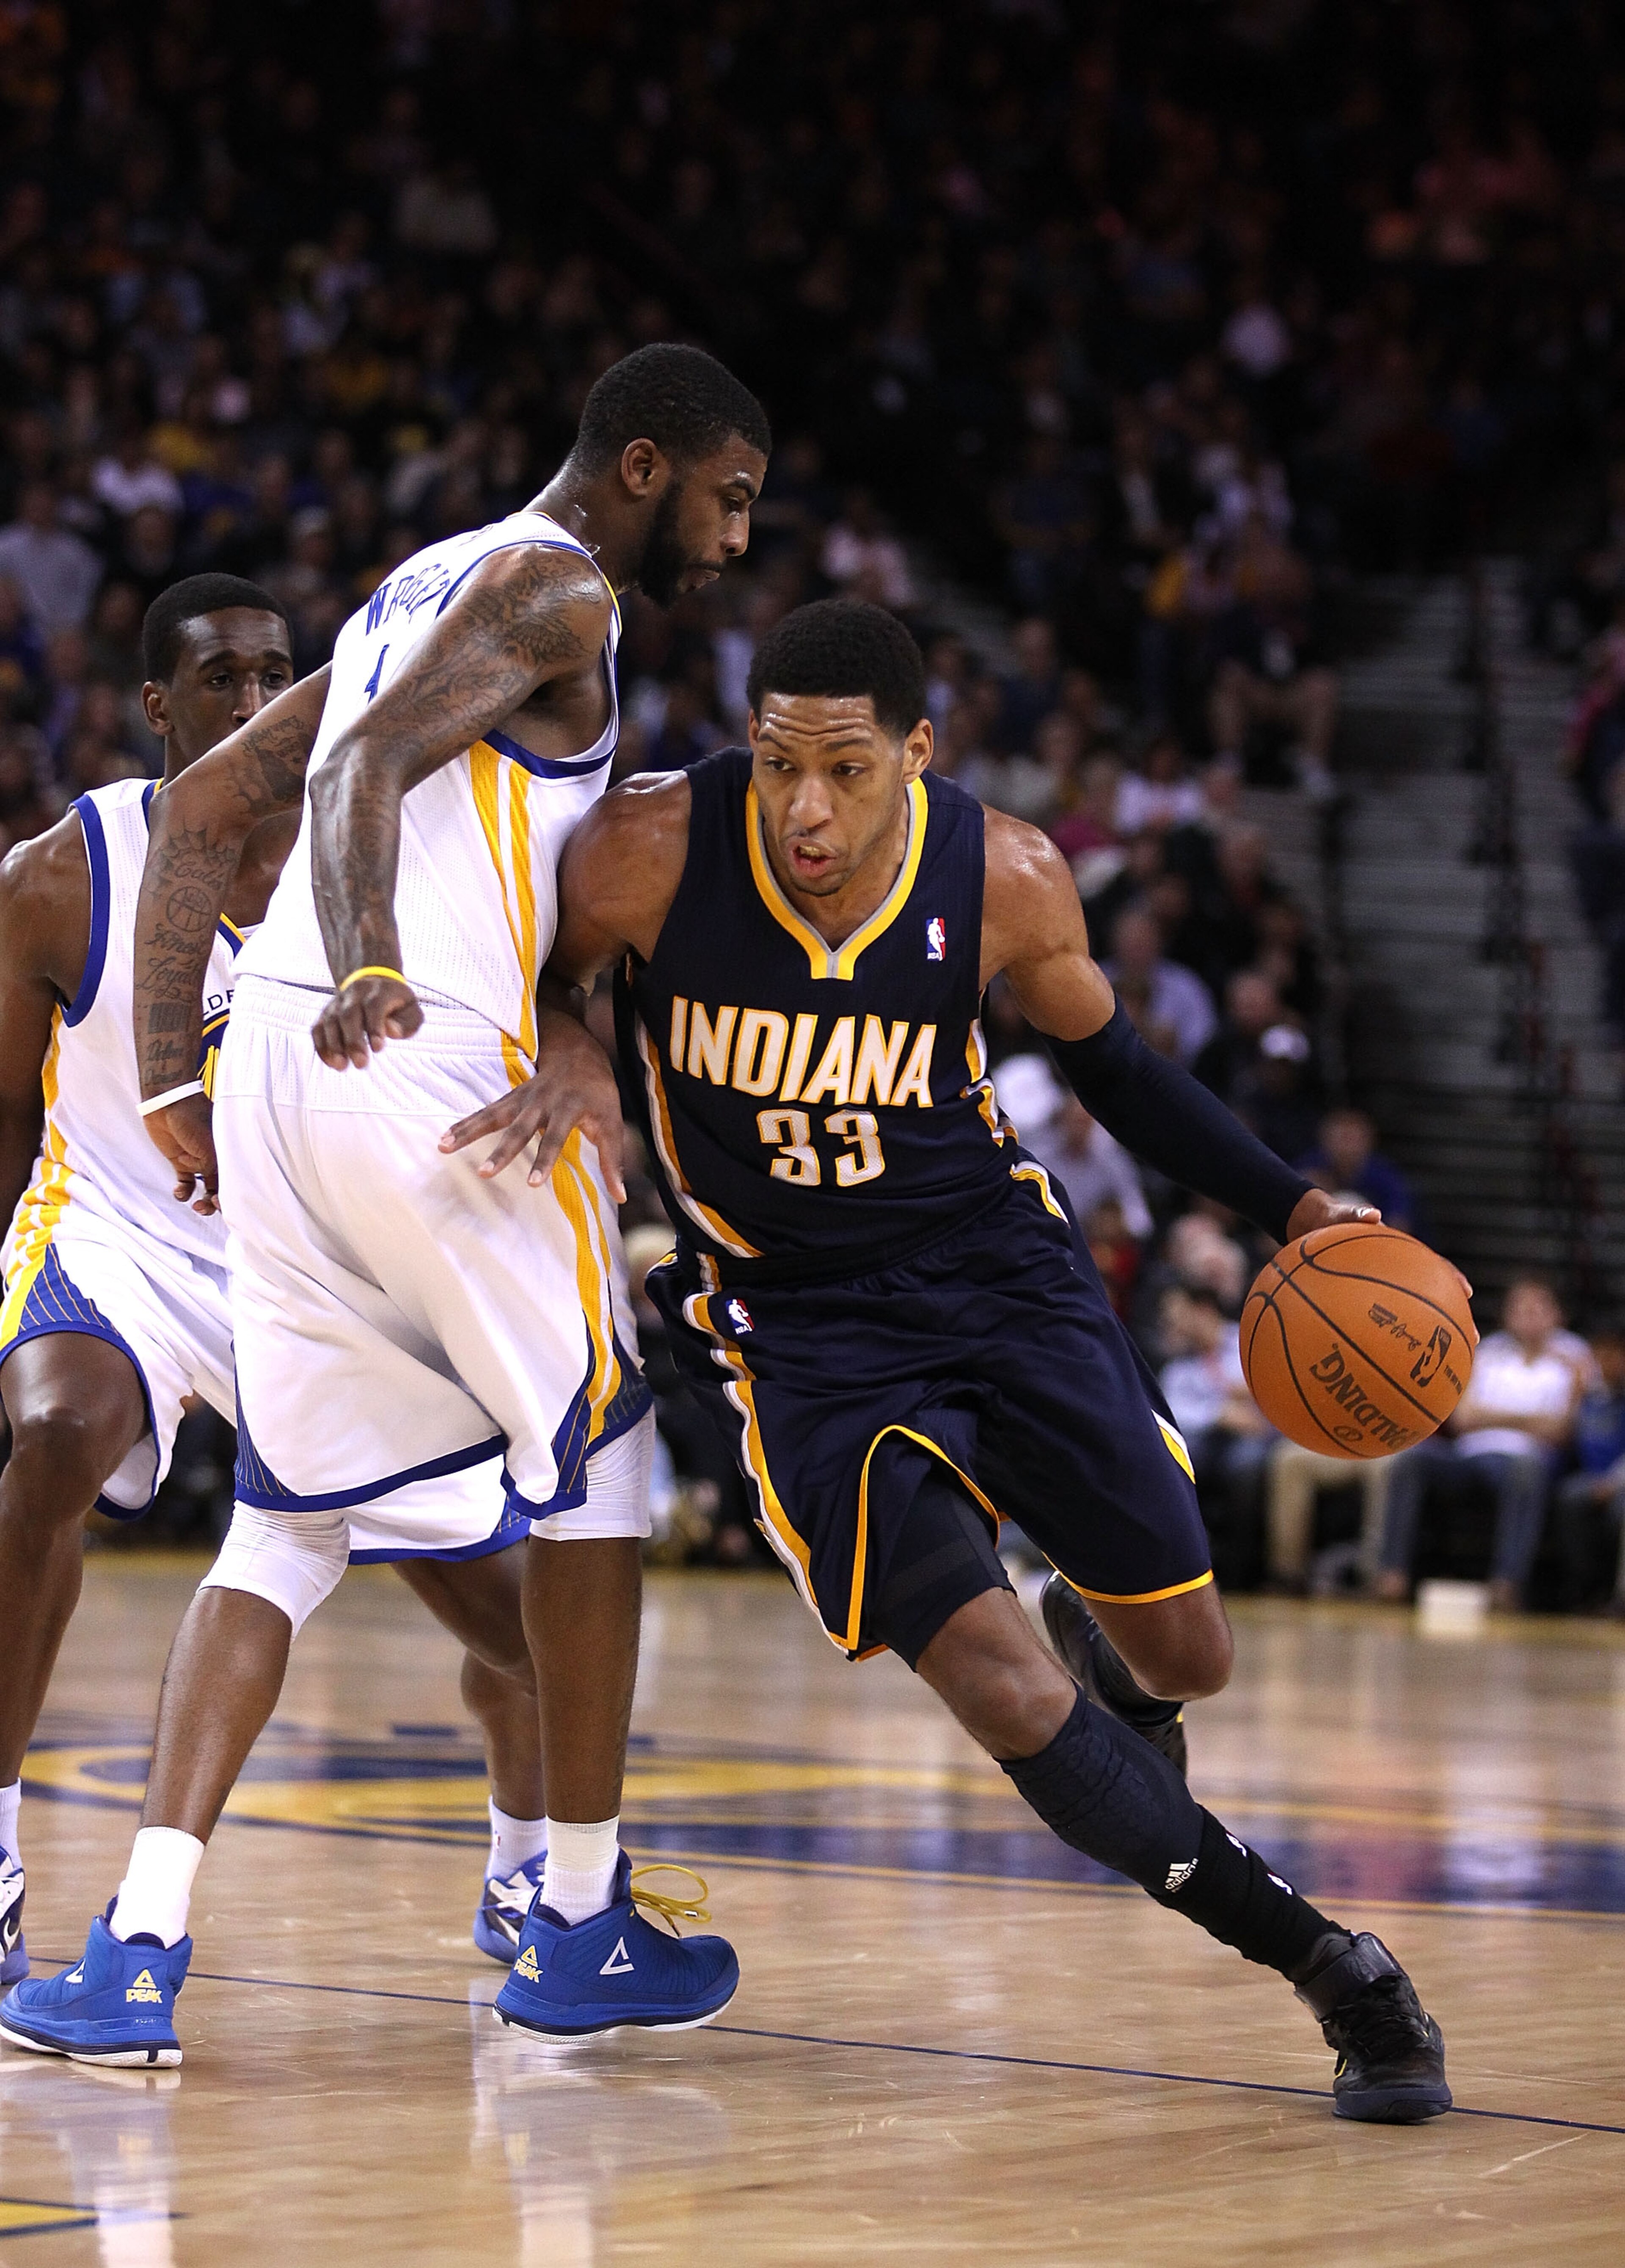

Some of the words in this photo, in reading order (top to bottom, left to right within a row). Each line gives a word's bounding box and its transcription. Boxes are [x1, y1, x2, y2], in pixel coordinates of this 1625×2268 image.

[669, 995, 936, 1108] INDIANA
[756, 1109, 885, 1186] 33
[126, 1988, 162, 2004] PEAK
[514, 1958, 543, 1983] PEAK
